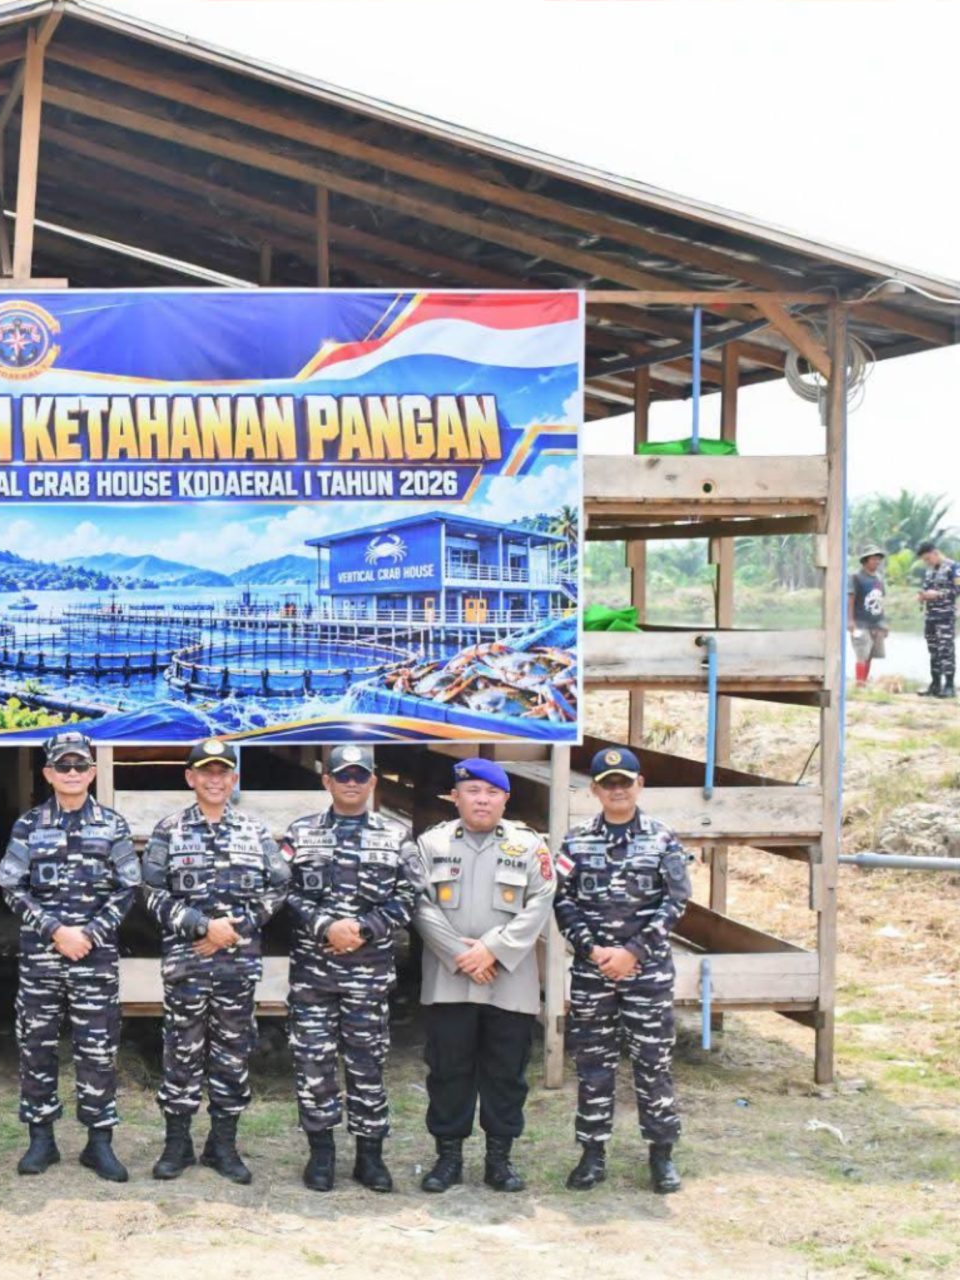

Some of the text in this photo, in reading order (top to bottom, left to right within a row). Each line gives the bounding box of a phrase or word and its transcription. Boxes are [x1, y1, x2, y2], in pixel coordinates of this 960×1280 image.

[22, 394, 297, 461] KETAHANAN
[304, 393, 502, 461] PANGAN
[28, 470, 90, 497] CRAB
[96, 470, 172, 497] HOUSE
[178, 470, 299, 497] KODAERAL
[304, 470, 312, 497] I
[317, 470, 393, 497] TAHUN
[399, 470, 458, 497] 2026
[337, 563, 435, 583] VERTICAL CRAB HOUSE
[496, 857, 528, 869] POLRI
